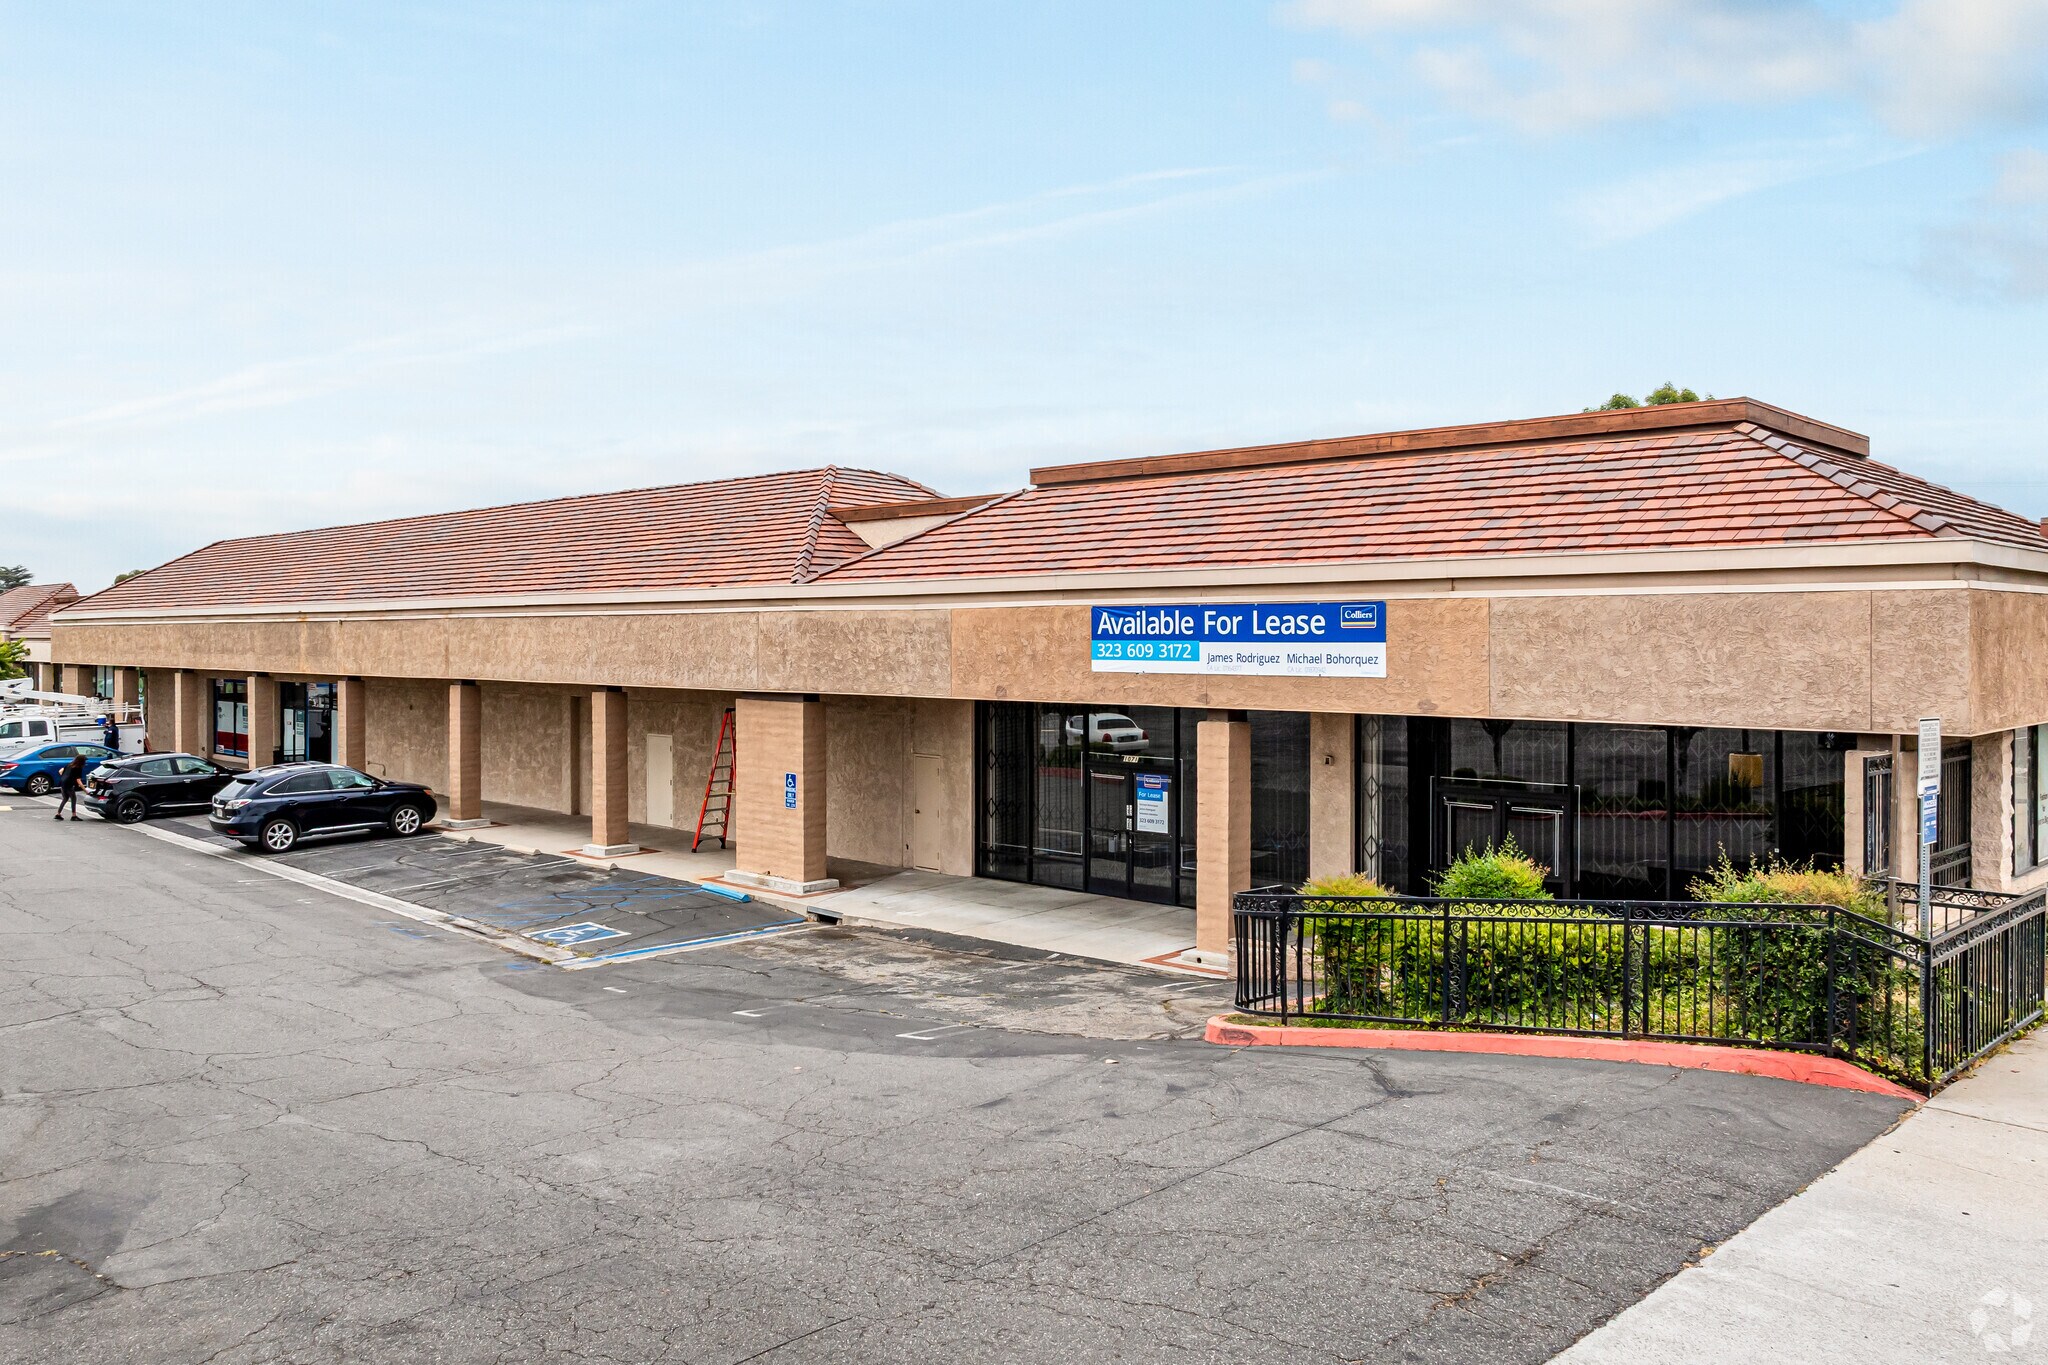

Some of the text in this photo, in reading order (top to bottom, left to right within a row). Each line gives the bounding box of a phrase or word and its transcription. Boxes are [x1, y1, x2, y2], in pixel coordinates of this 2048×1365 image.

[1344, 610, 1373, 619] Colliers
[1097, 610, 1326, 635] Available For Lease
[1097, 643, 1192, 658] 323 609 3172
[1207, 652, 1280, 666] James Rodriguez
[1287, 653, 1379, 667] Michael Bohorquez
